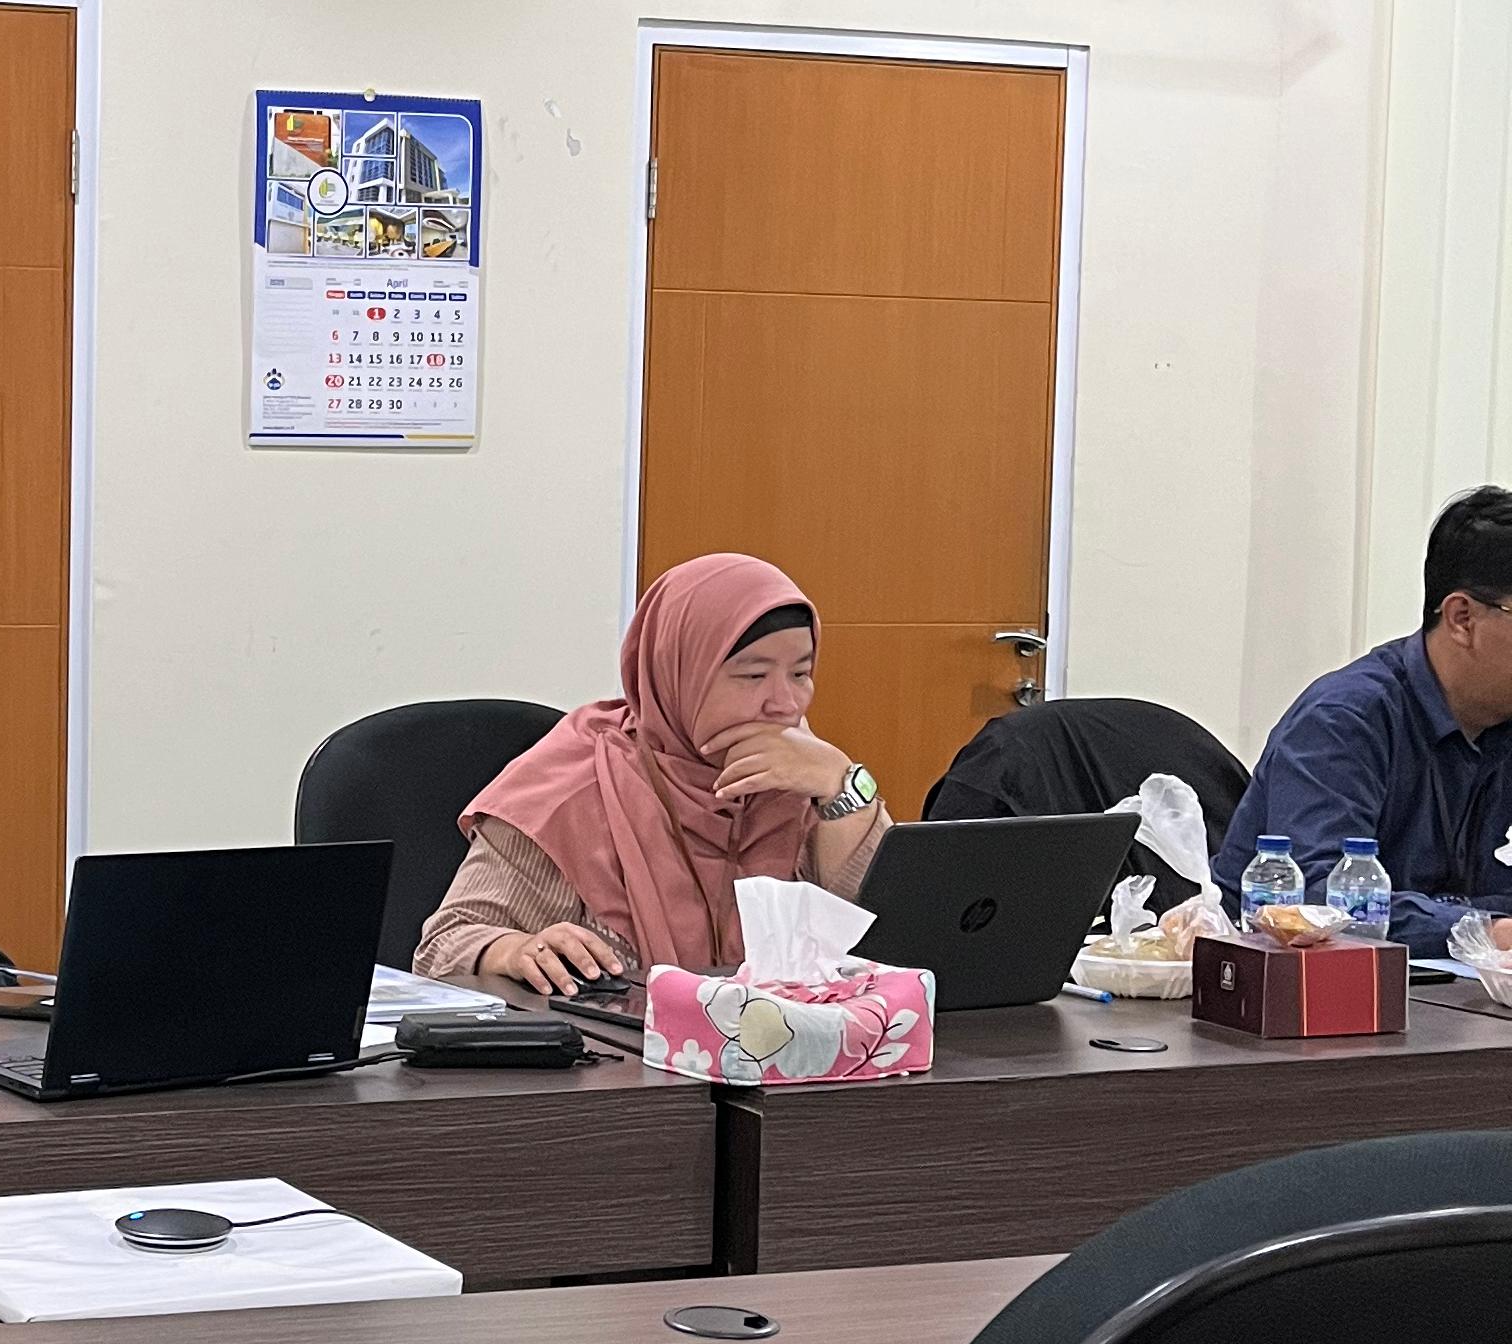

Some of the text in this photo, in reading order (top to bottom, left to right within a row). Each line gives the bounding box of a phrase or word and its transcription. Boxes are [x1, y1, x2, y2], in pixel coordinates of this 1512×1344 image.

[386, 278, 409, 289] April
[373, 309, 461, 320] 1 2 3 4 5
[332, 330, 464, 343] 6 7 8 9 10 11 12
[328, 353, 463, 366] 13 14 15 16 17 18 19
[327, 376, 463, 388] 20 21 22 23 24 25 26
[327, 399, 342, 409] 27
[348, 399, 362, 409] 28
[368, 399, 383, 410] 29
[388, 399, 403, 410] 30
